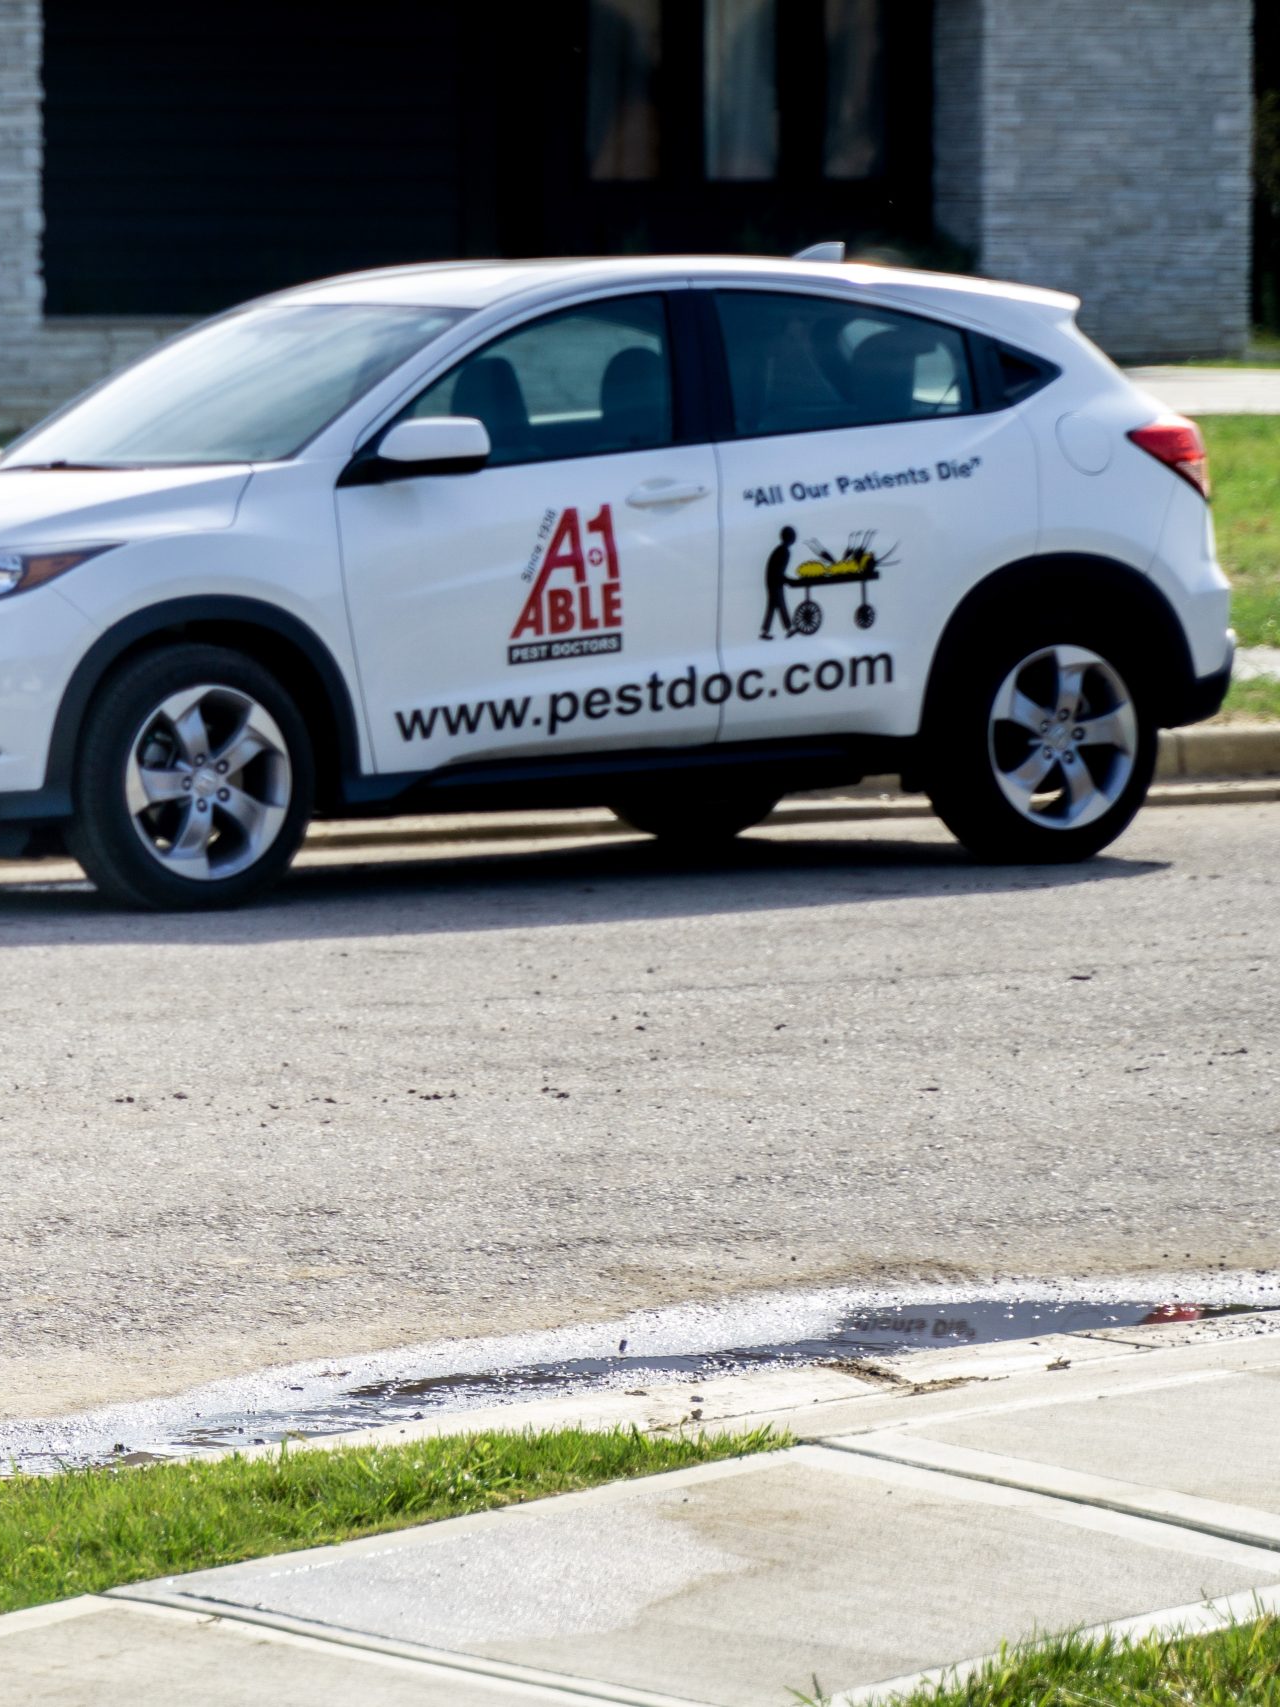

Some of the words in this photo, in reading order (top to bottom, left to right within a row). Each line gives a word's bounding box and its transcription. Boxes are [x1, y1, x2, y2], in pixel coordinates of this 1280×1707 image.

[790, 481, 830, 502] Our
[835, 466, 930, 495] Patients
[521, 544, 543, 583] Since
[510, 583, 622, 639] ABLE
[511, 644, 549, 662] PEST
[551, 637, 619, 657] DOCTORS
[396, 652, 894, 742] www.pestdoc.com
